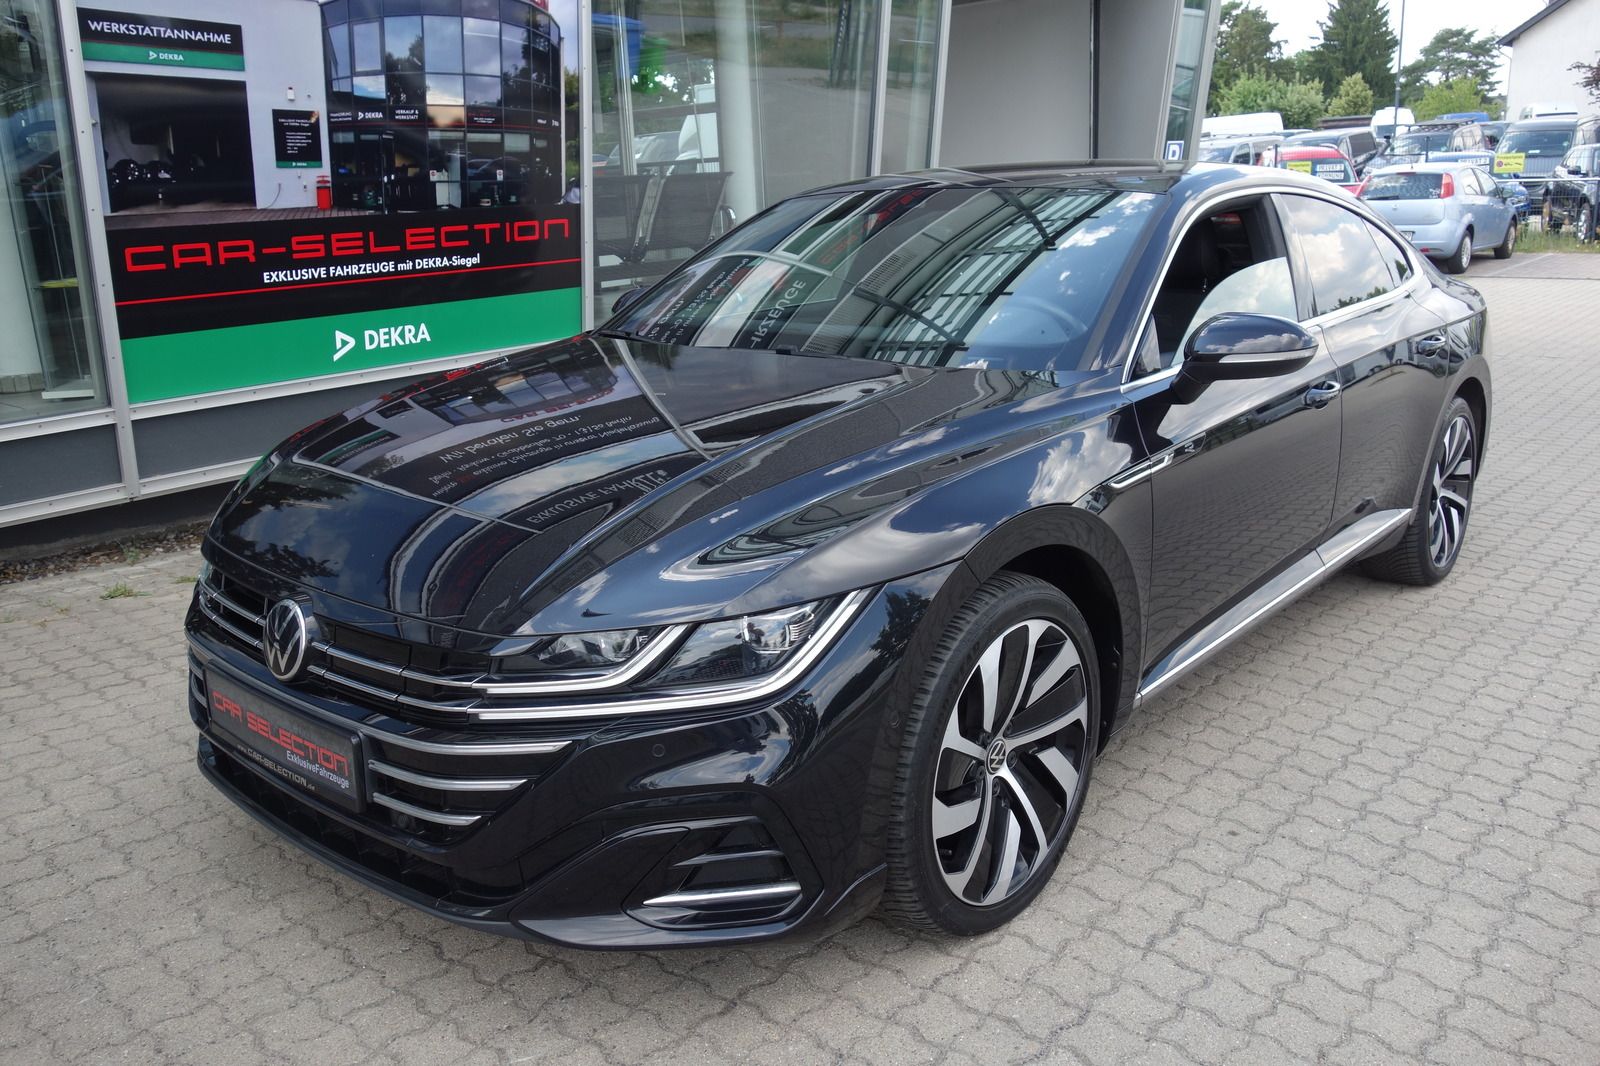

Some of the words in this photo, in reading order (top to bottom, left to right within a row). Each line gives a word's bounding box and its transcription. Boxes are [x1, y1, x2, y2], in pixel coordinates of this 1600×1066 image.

[88, 20, 232, 44] WERKSTATTANNAHME
[159, 53, 184, 61] DEKRA
[124, 218, 569, 272] CAR-SELECTION
[263, 267, 327, 283] EXKLUSIVE
[329, 261, 395, 277] FAHRZEUGE
[397, 259, 413, 271] mit
[415, 253, 480, 269] DEKRA-Siegel
[364, 323, 431, 351] DEKRA
[212, 690, 242, 723] CAR
[247, 711, 348, 776] SELECTION
